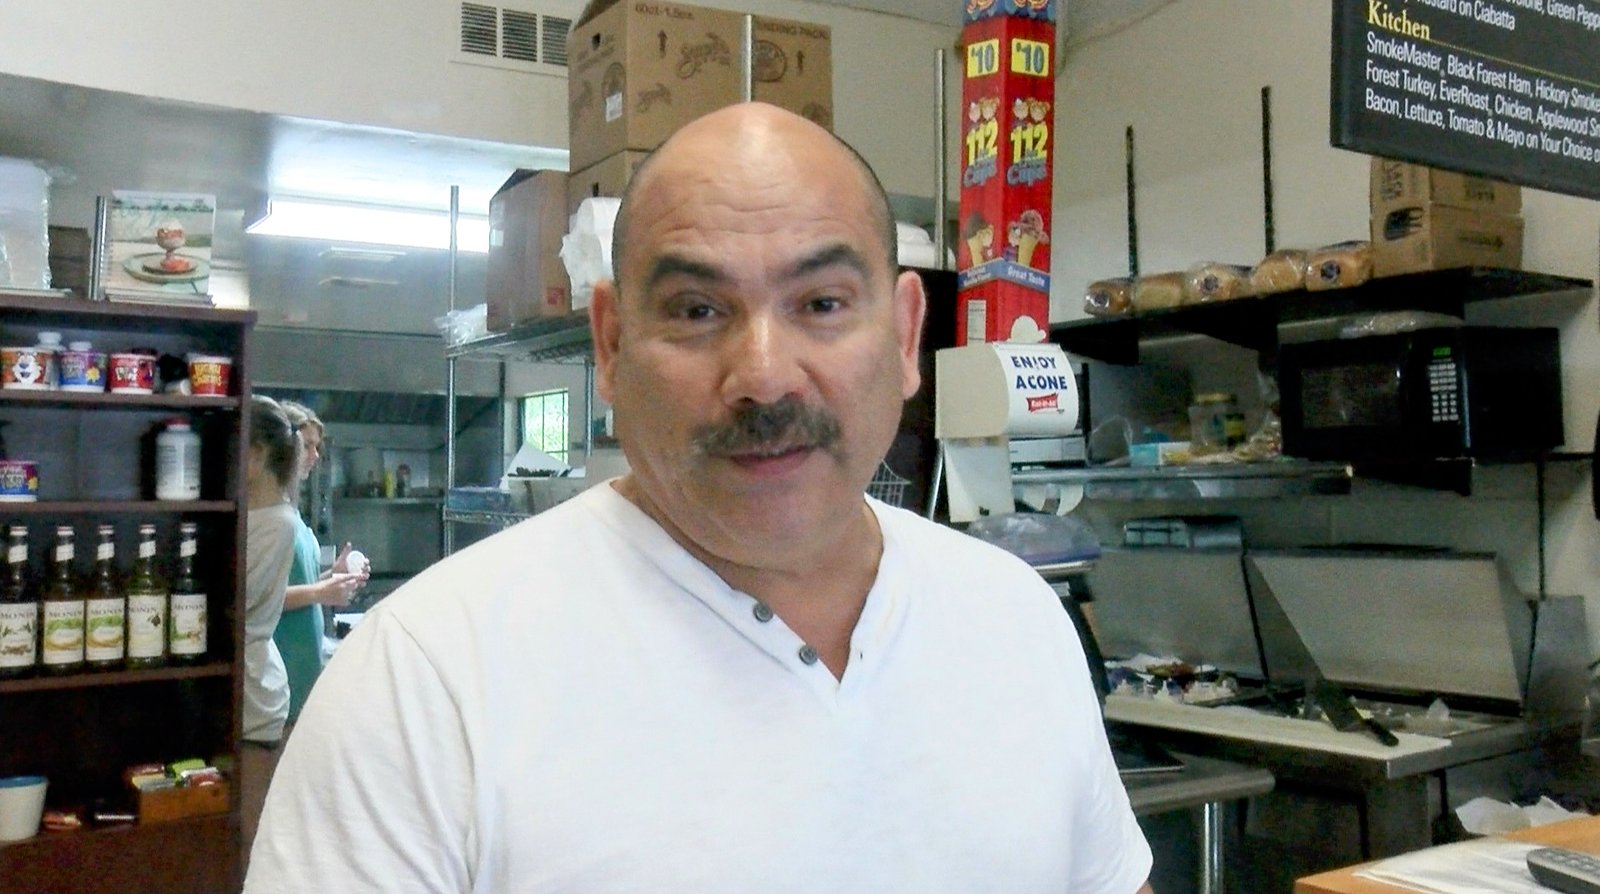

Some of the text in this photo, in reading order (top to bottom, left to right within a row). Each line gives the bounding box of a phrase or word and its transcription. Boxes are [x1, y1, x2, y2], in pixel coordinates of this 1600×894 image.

[1367, 0, 1430, 40] Kitchen
[1459, 1, 1472, 17] on
[1474, 0, 1515, 31] Ciabatta
[1547, 0, 1576, 21] Green
[1366, 59, 1400, 88] Forest
[1402, 68, 1437, 101] Turkey,
[1495, 94, 1534, 124] Chicken,
[1537, 105, 1589, 135] Applewood
[1447, 54, 1475, 80] Black
[1477, 63, 1507, 89] Forest
[1508, 72, 1533, 98] Ham,
[1535, 78, 1570, 108] Hickory
[966, 117, 999, 167] 112
[1010, 121, 1049, 165] 112
[1365, 88, 1402, 119] Bacon,
[1405, 98, 1446, 129] Lettuce,
[1447, 108, 1485, 136] Tomato
[1486, 118, 1495, 139] &
[1497, 120, 1525, 149] Mayo
[1526, 133, 1539, 149] on
[1540, 131, 1561, 153] Your
[1562, 136, 1593, 161] Choice
[1007, 265, 1028, 281] Great
[1011, 355, 1057, 369] ENJOY
[1016, 374, 1068, 390] A CONE
